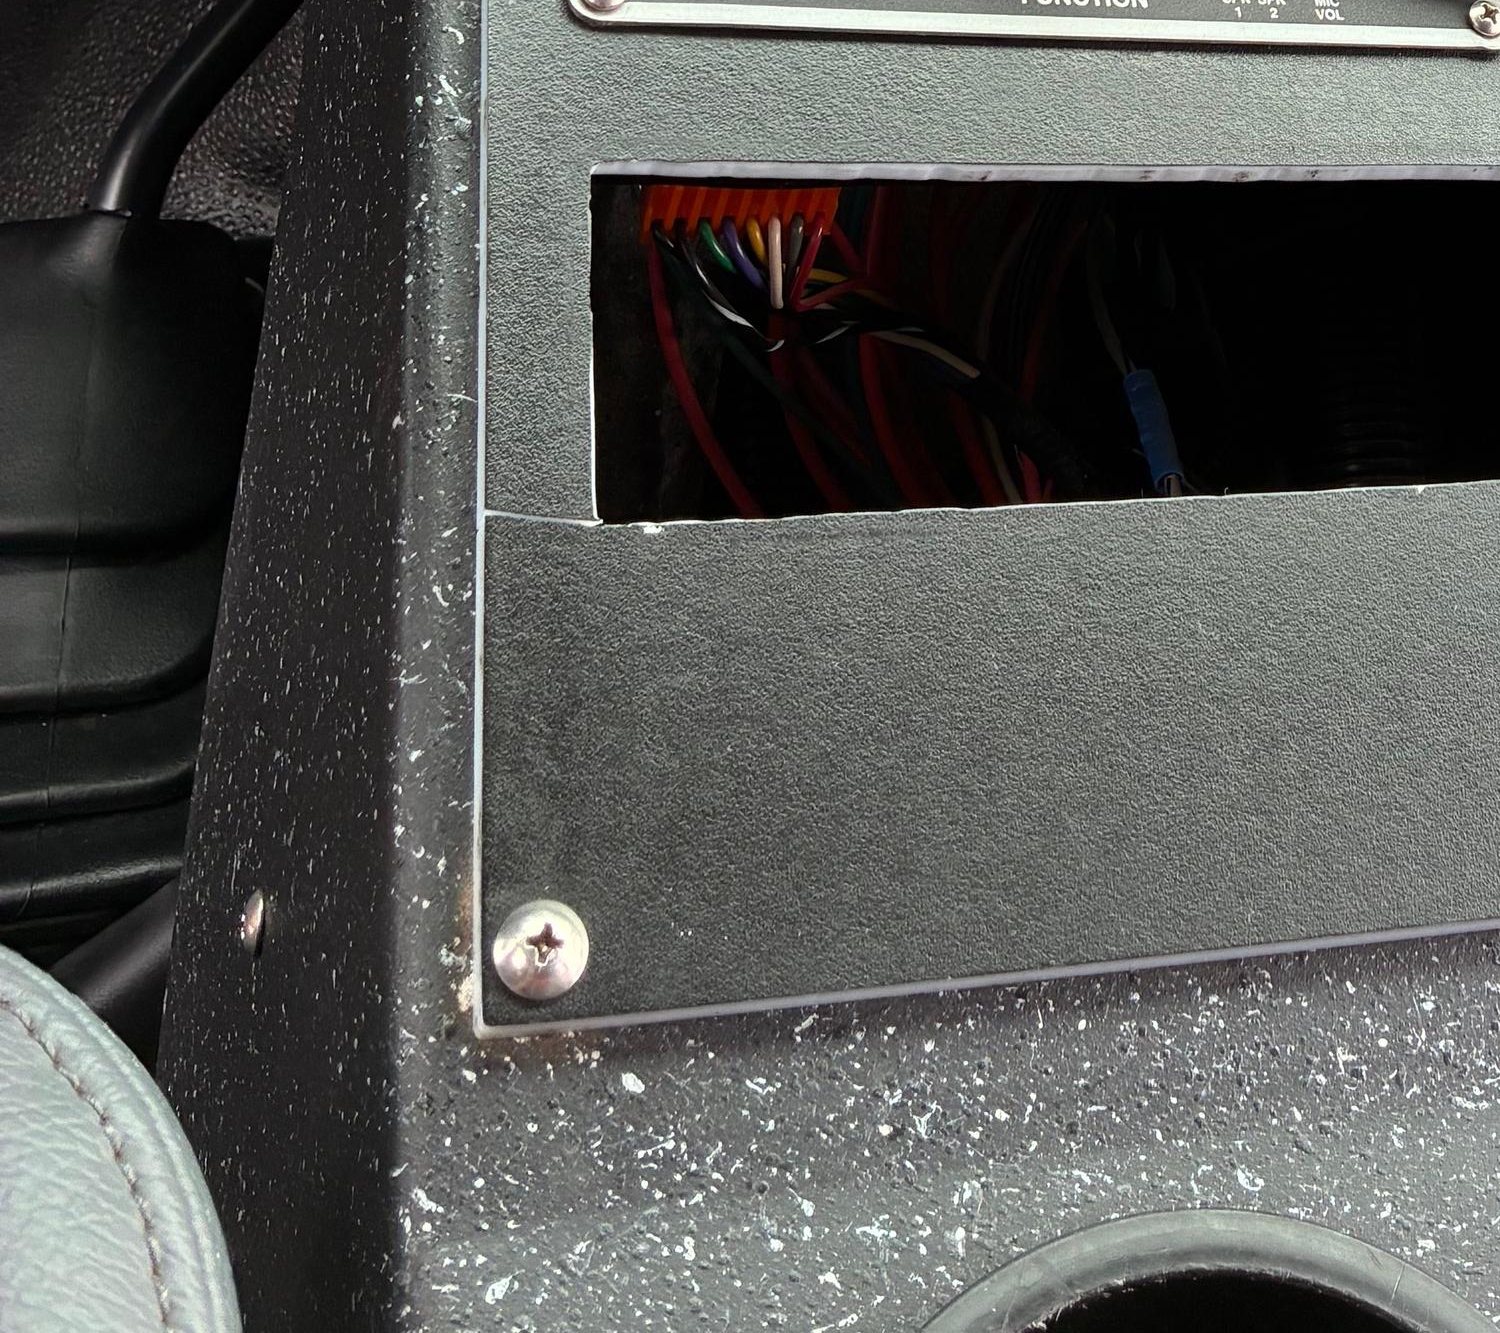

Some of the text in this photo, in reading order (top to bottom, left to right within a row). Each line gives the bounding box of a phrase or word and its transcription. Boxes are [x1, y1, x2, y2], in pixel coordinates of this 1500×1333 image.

[1234, 6, 1242, 18] 1
[1269, 7, 1279, 19] 2
[1314, 8, 1345, 21] VOL
